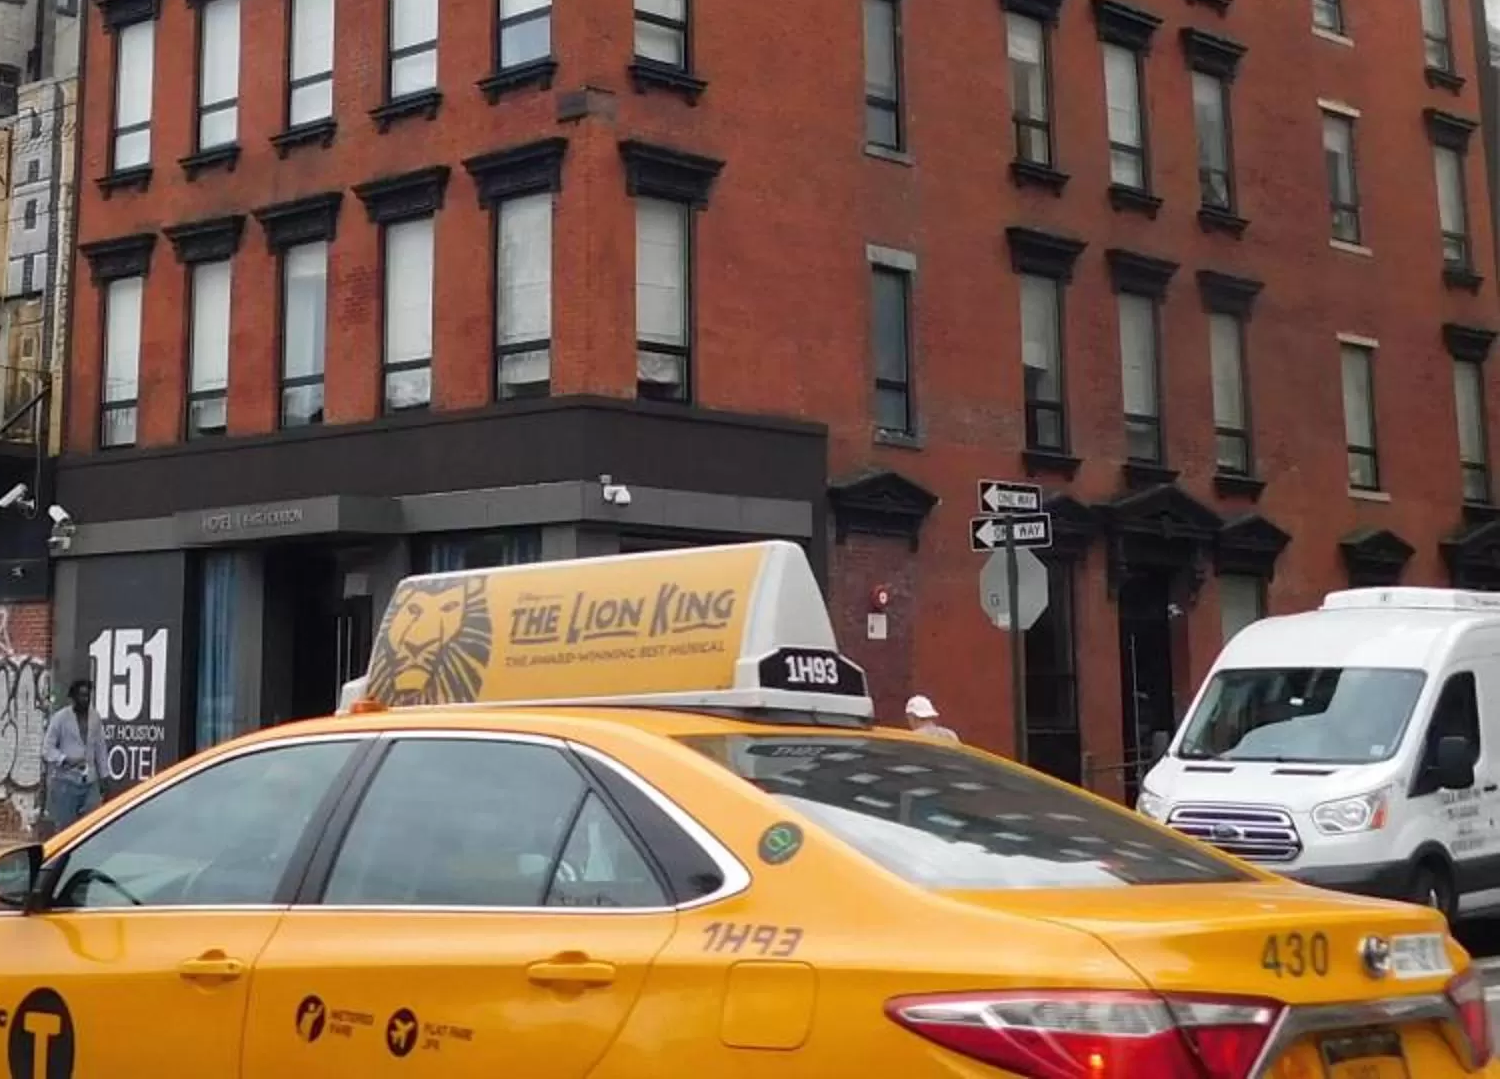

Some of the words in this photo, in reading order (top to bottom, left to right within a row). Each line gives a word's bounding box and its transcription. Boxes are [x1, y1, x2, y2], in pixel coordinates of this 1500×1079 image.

[1018, 525, 1042, 538] WAY
[509, 604, 562, 645] THE
[89, 628, 168, 721] 151
[784, 655, 839, 684] 1H93
[117, 725, 165, 741] HOUSTON
[702, 922, 804, 957] 1H93
[1261, 932, 1329, 978] 430
